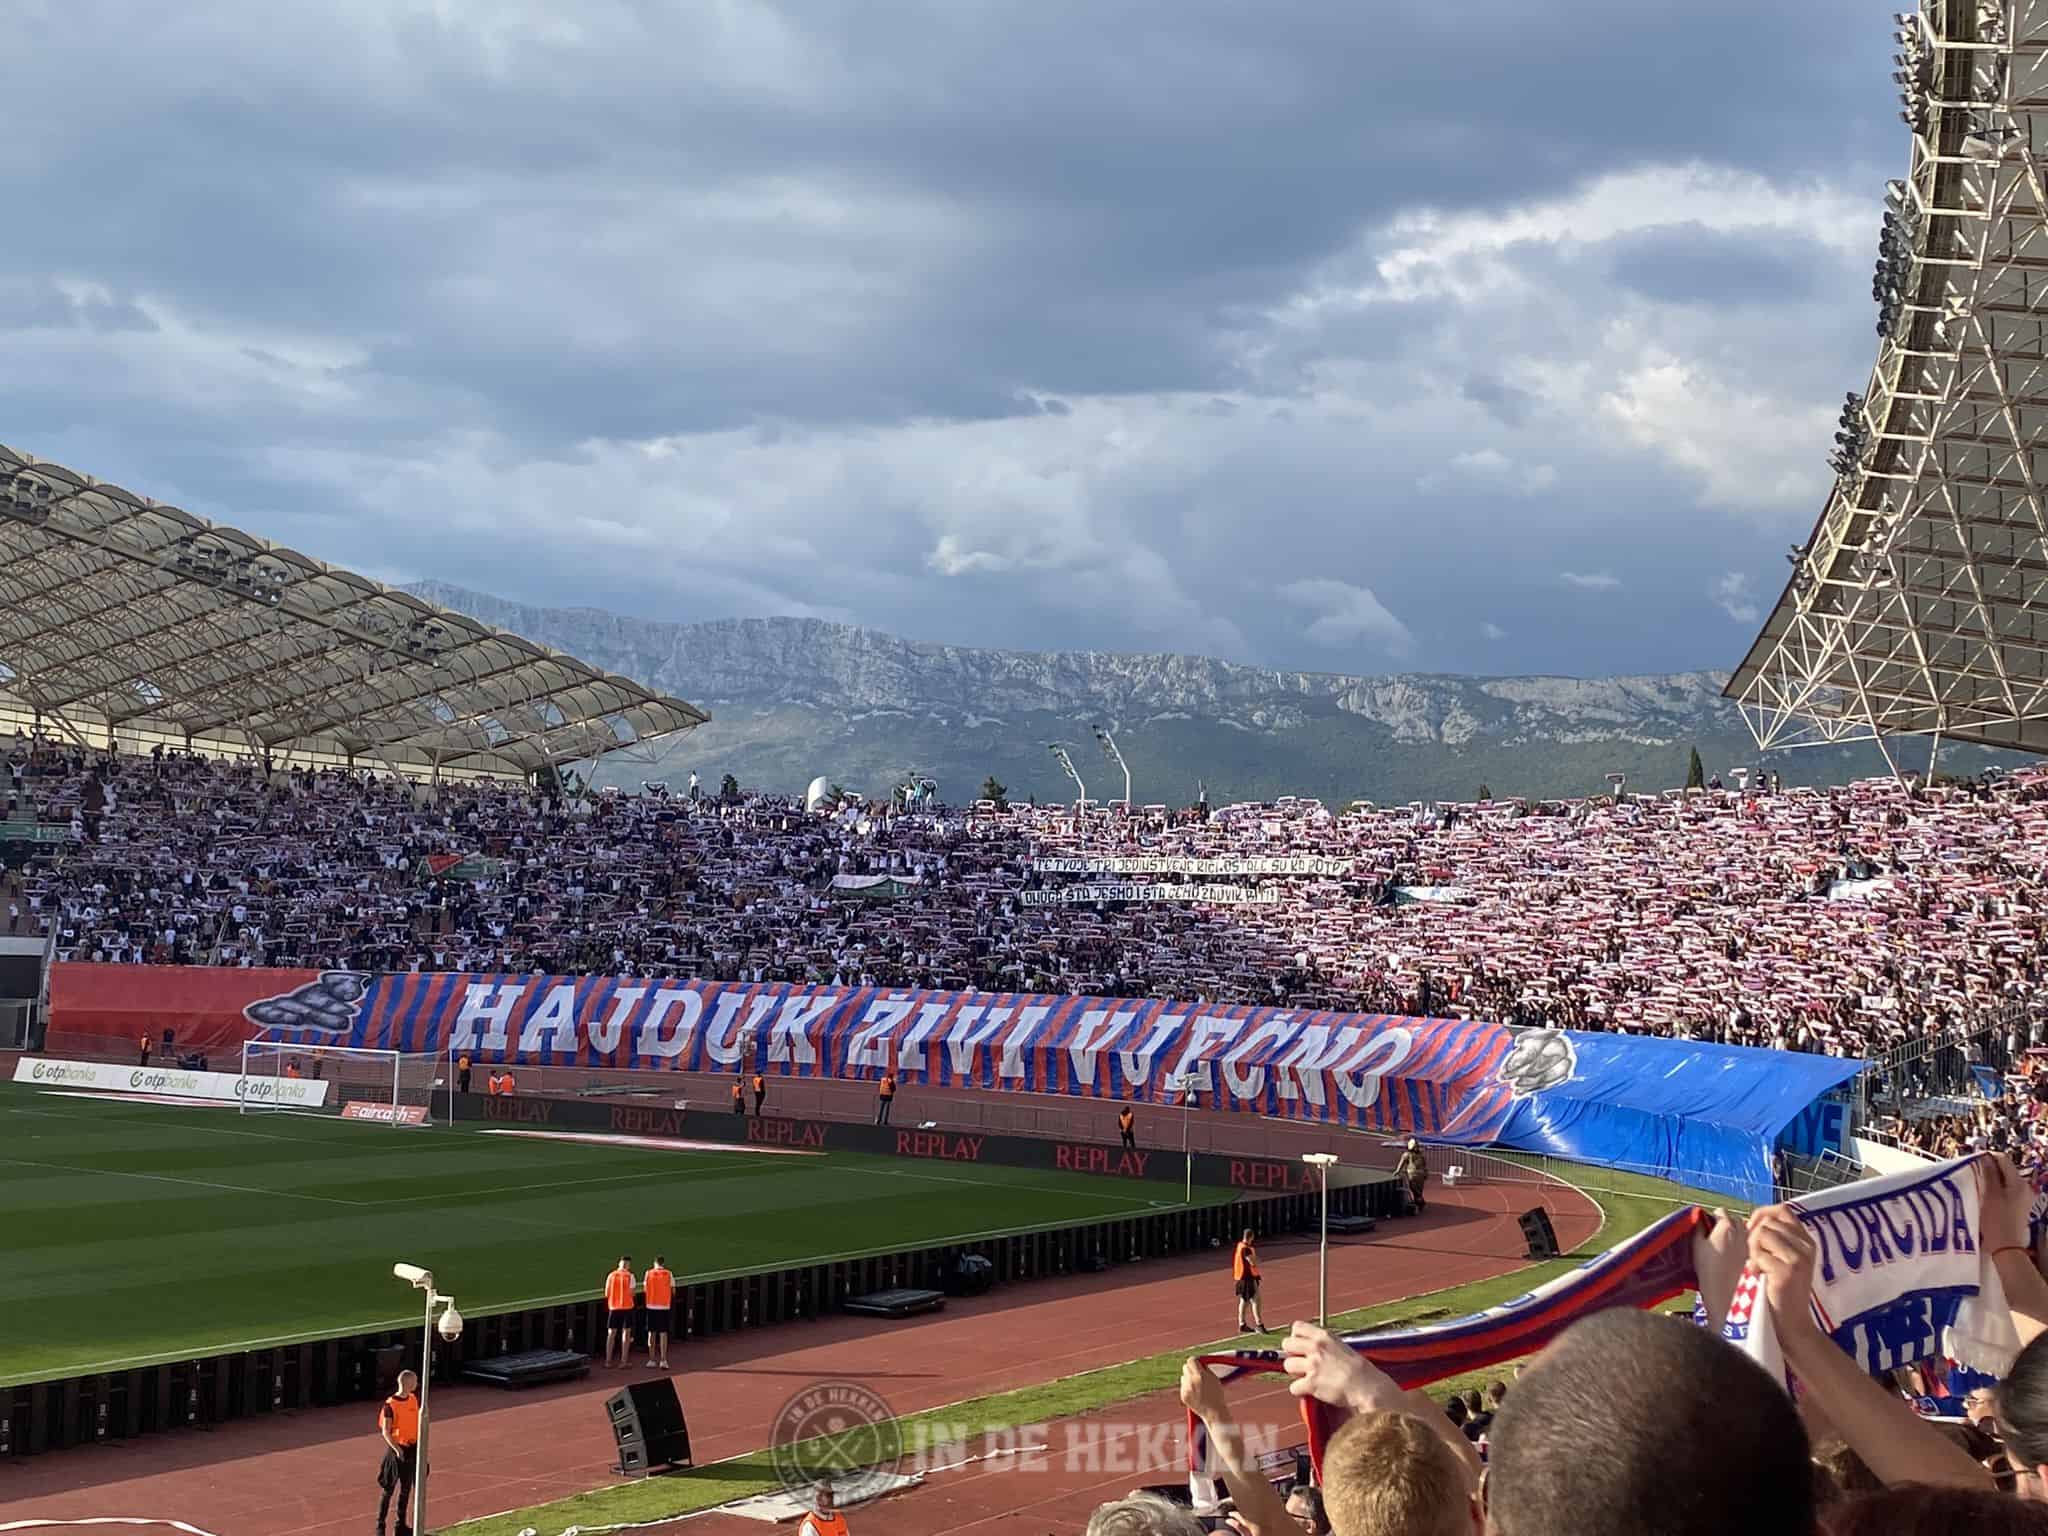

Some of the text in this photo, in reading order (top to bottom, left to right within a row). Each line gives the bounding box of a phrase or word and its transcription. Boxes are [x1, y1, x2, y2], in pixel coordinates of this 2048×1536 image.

[449, 983, 1413, 1109] HAJDUK ŽIVI VJEČNO
[483, 1097, 553, 1122] REPLAY
[611, 1105, 687, 1135] REPLAY
[750, 1118, 831, 1147] REPLAY
[897, 1131, 986, 1162] REPLAY
[1056, 1144, 1151, 1178] REPLAY
[1230, 1159, 1322, 1192] REPLA
[1804, 1178, 1977, 1285] TORCIDA
